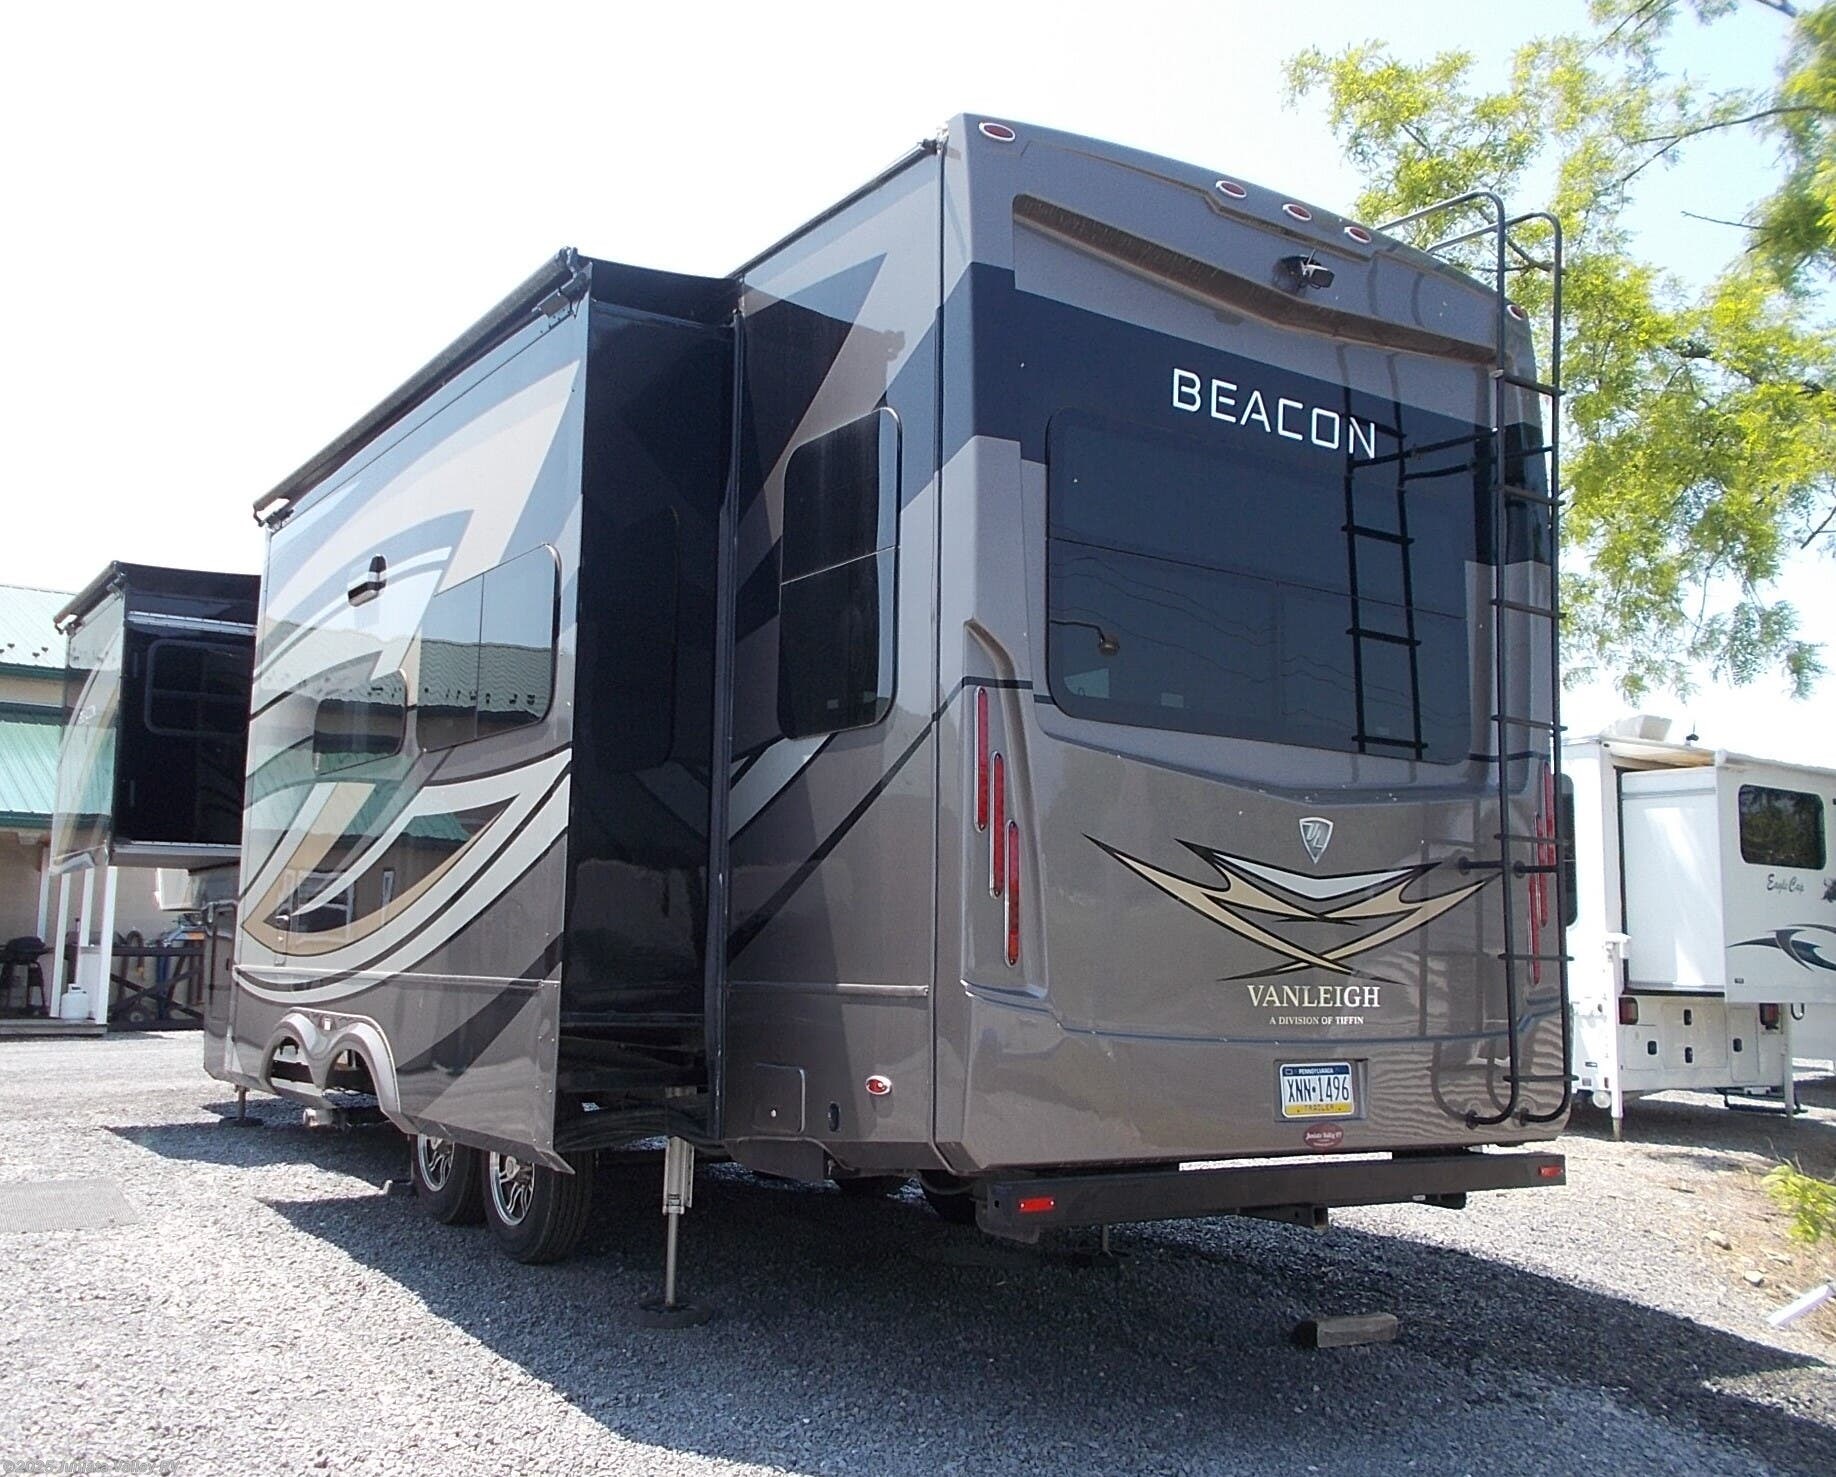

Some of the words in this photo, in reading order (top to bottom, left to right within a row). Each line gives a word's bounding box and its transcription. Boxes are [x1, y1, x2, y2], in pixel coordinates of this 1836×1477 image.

[1172, 368, 1376, 459] BEACON
[1247, 984, 1381, 1008] VANLEIGH
[1269, 1016, 1277, 1025] A
[1278, 1016, 1319, 1025] DIVISION
[1321, 1016, 1333, 1025] OF
[1335, 1016, 1364, 1025] TIFFIN
[1298, 1067, 1334, 1075] PENNSYLVANIA
